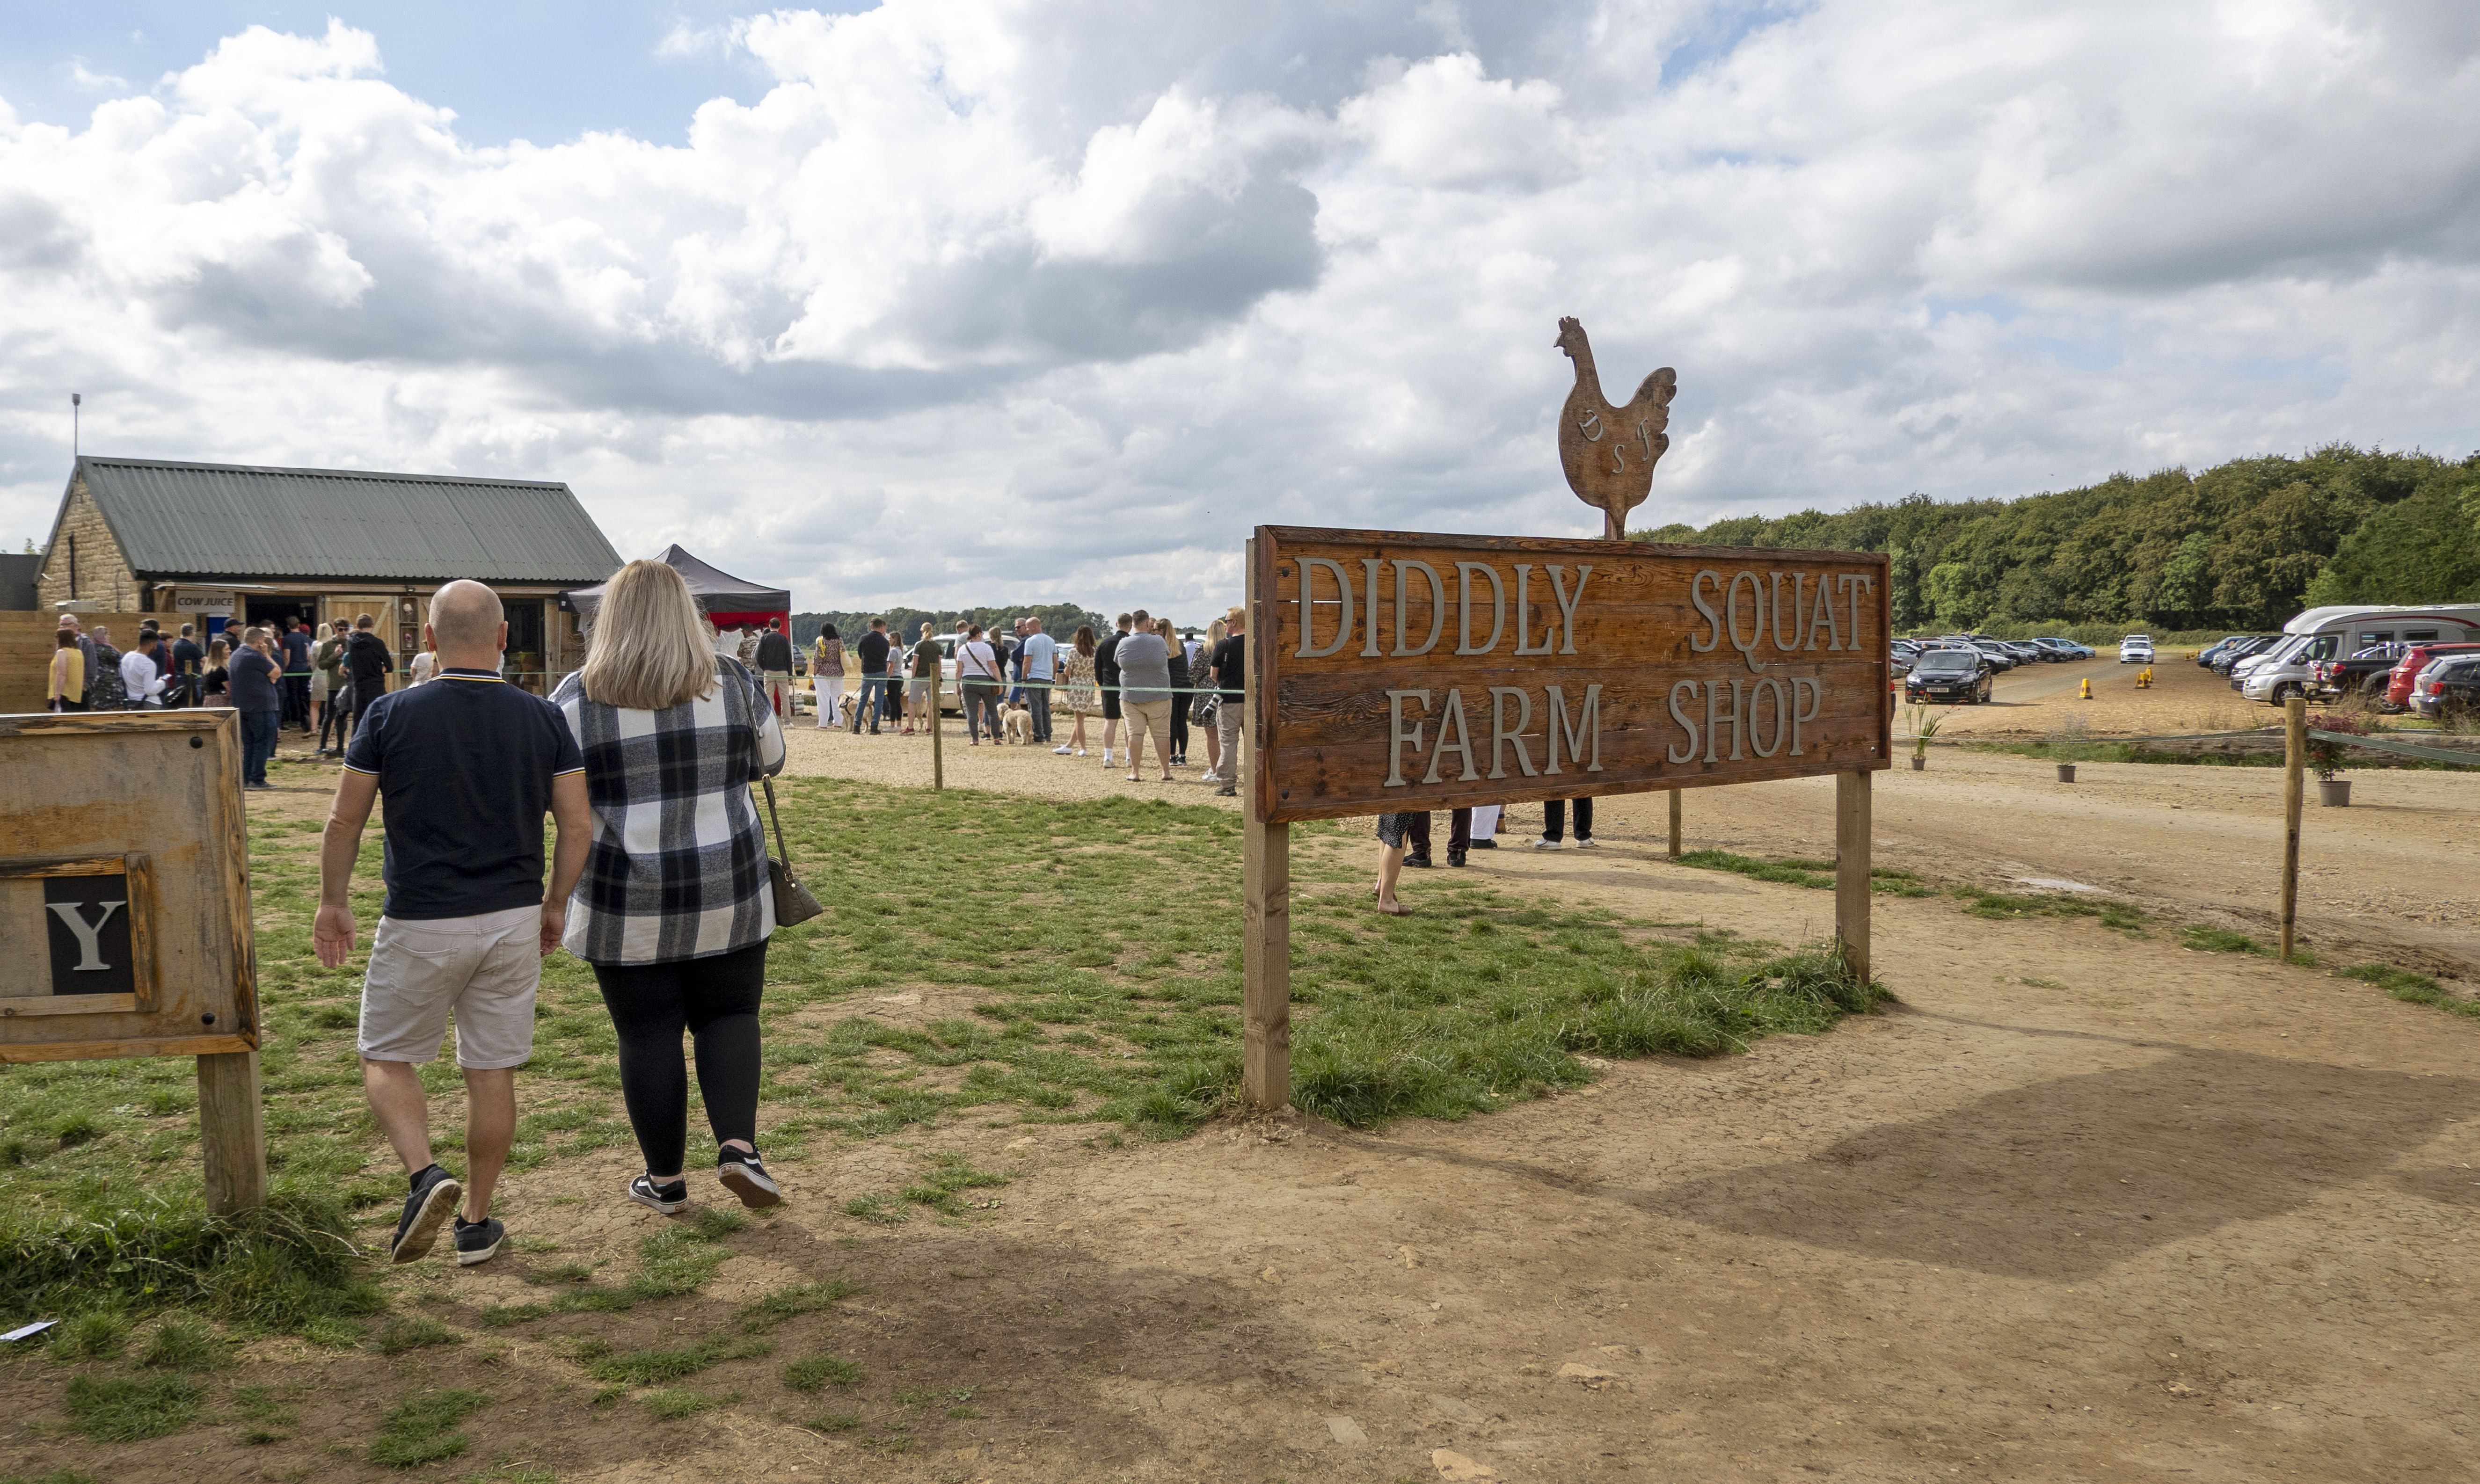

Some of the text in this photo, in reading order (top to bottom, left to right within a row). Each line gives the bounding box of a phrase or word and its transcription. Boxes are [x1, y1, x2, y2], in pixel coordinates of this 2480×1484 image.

[1578, 409, 1650, 474] D S F
[178, 597, 203, 606] COW
[1295, 557, 1870, 673] DIDDLY SQUAT
[1384, 677, 1821, 787] FARM SHOP
[45, 901, 127, 970] Y
